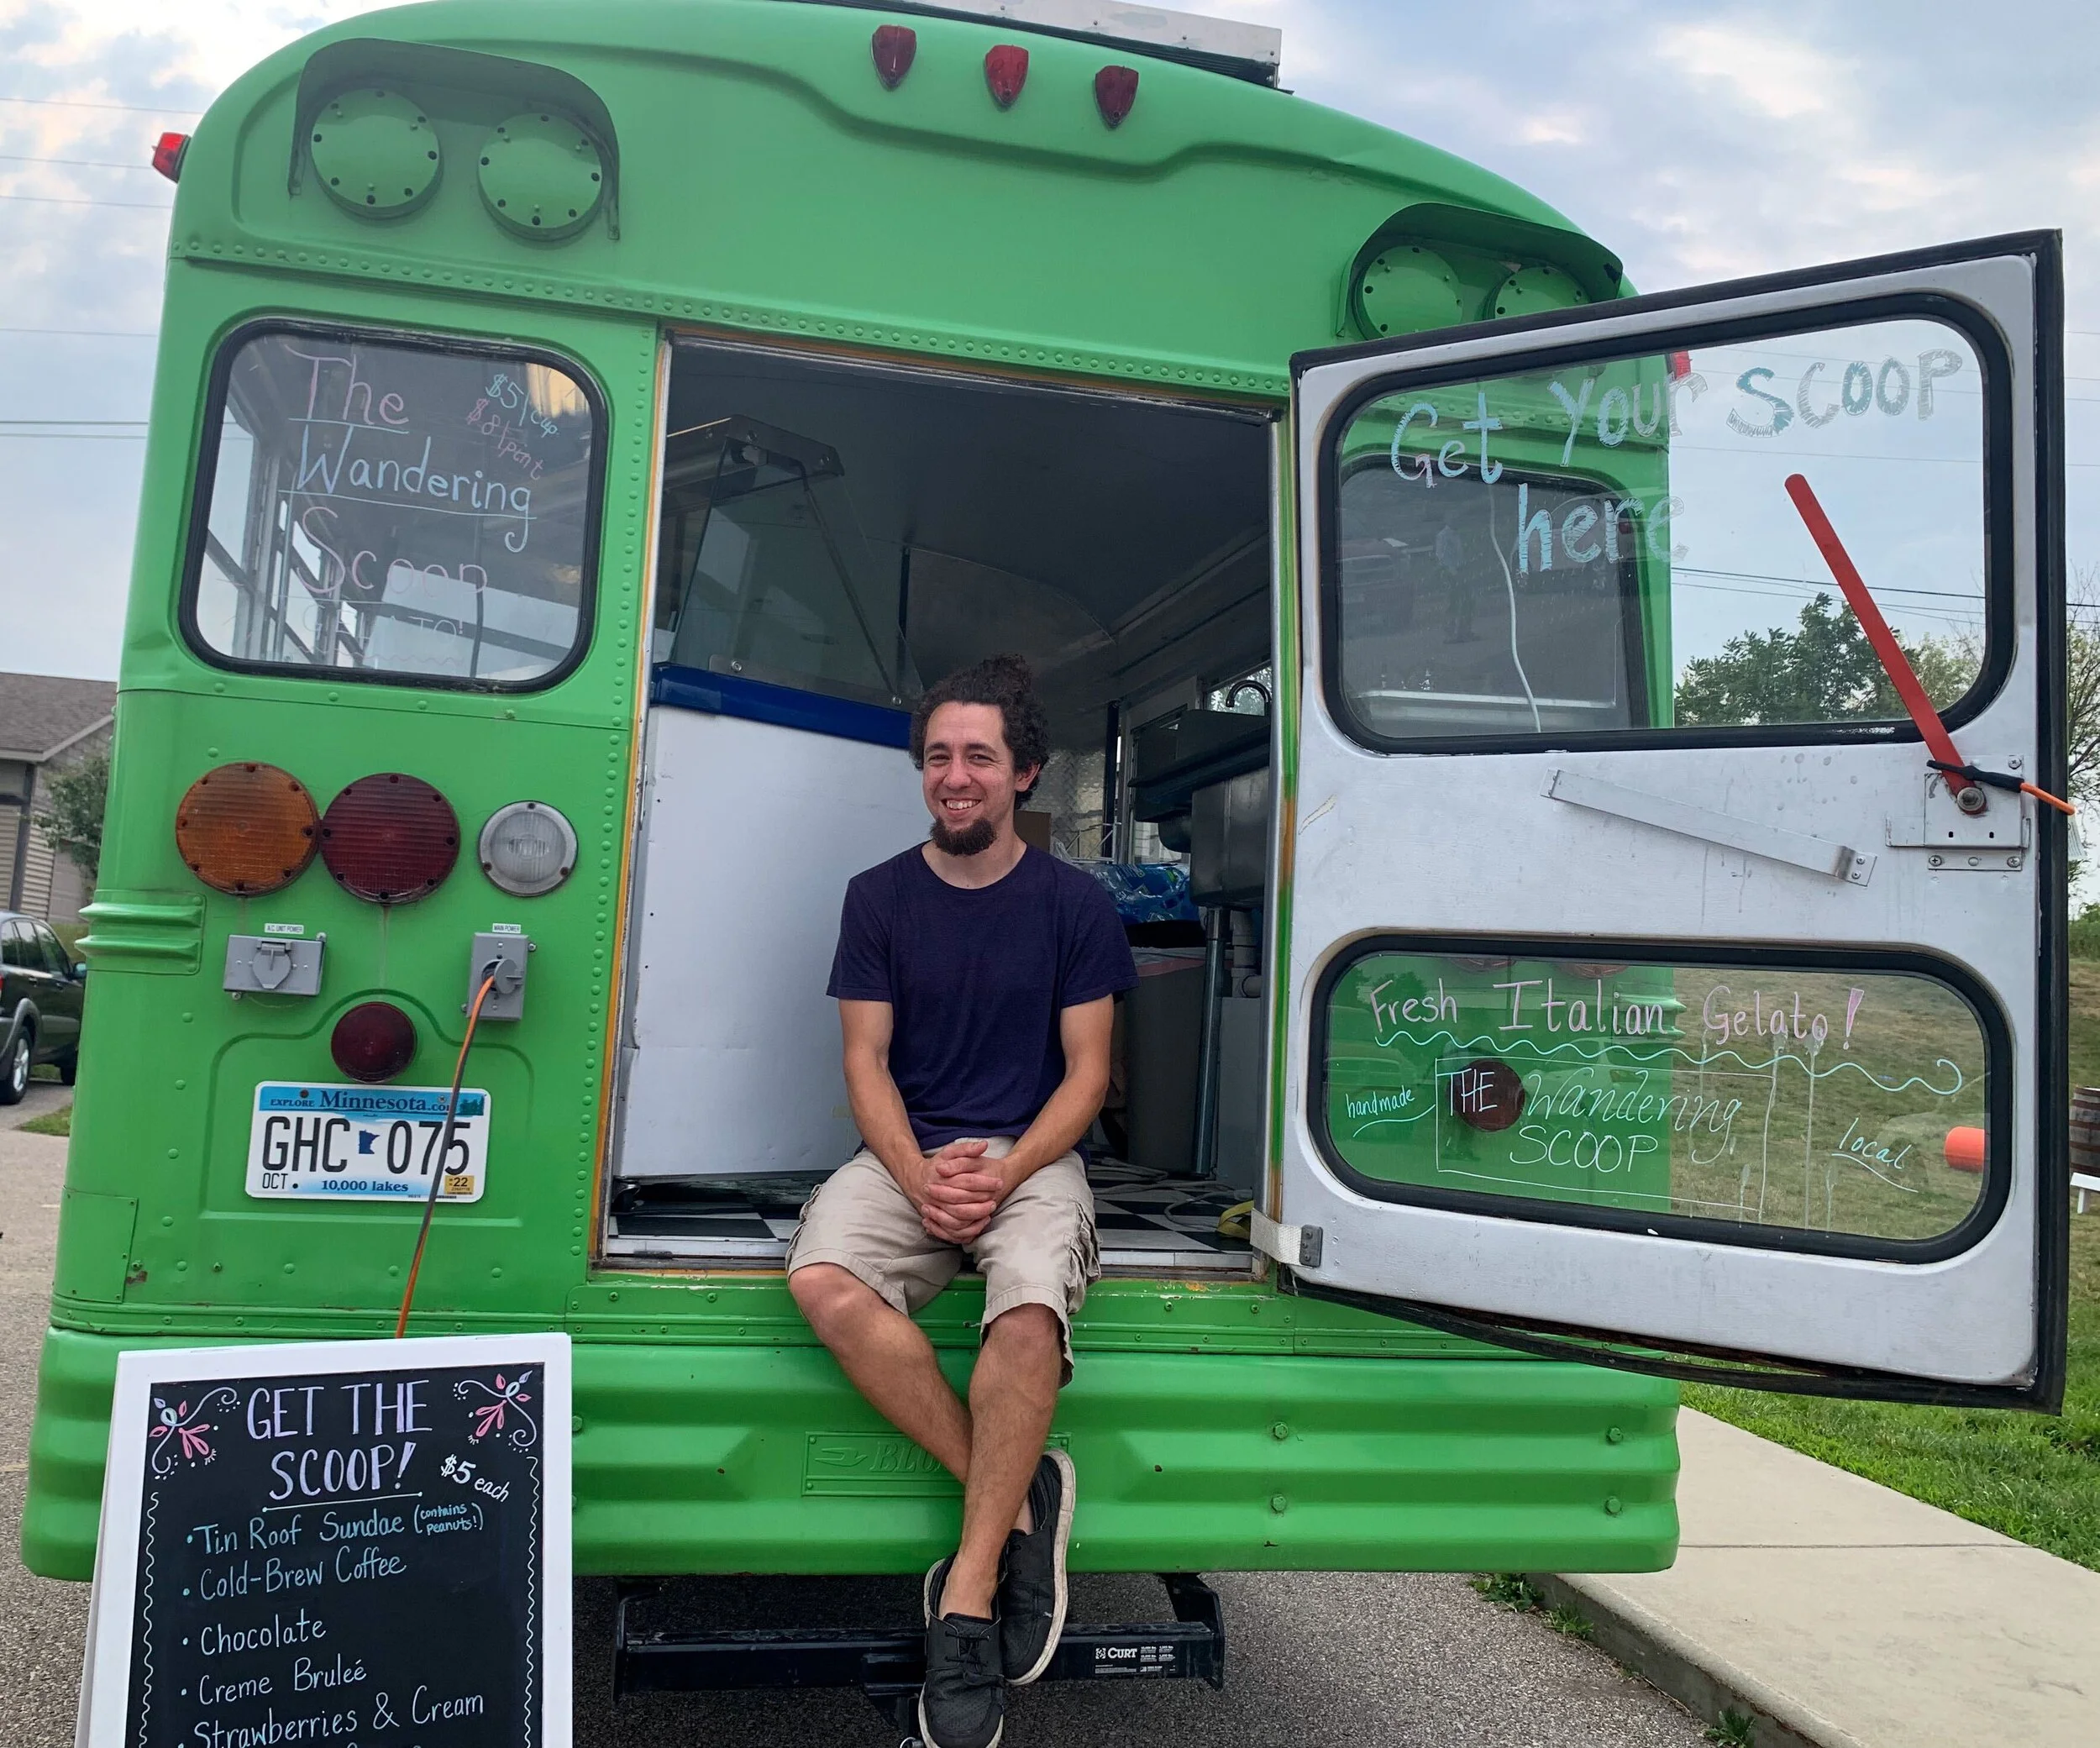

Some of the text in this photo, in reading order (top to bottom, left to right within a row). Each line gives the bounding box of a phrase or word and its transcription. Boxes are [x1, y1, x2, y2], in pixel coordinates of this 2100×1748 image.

[285, 344, 409, 426] The
[1391, 392, 1503, 489] Get
[1725, 348, 1963, 438] SCOOP
[297, 424, 533, 553] Wandering
[1517, 483, 1688, 576] here
[1370, 977, 1457, 1033] Fresh
[1493, 978, 1668, 1035] Italian
[270, 1099, 315, 1107] EXPLORE
[1346, 1084, 1415, 1119] handmade
[1436, 1067, 1741, 1164] THE Wandering
[262, 1115, 470, 1175] GHC 075
[1509, 1126, 1658, 1173] SCOOP
[262, 1173, 288, 1189] OCT
[321, 1180, 409, 1192] 10,000 lakes
[454, 1178, 468, 1187] 22
[247, 1380, 433, 1440] GET THE
[269, 1441, 417, 1500] SCOOP!
[440, 1454, 510, 1502] $5 each
[193, 1525, 238, 1555] Tin
[249, 1514, 302, 1549] Roof
[319, 1512, 405, 1542] Sundae
[200, 1546, 407, 1600] Cold-Brew Coffee
[201, 1609, 327, 1656] Chocolate
[1107, 1647, 1137, 1659] CURT
[199, 1675, 273, 1706] Creme
[194, 1686, 484, 1748] Strawberries & Cream
